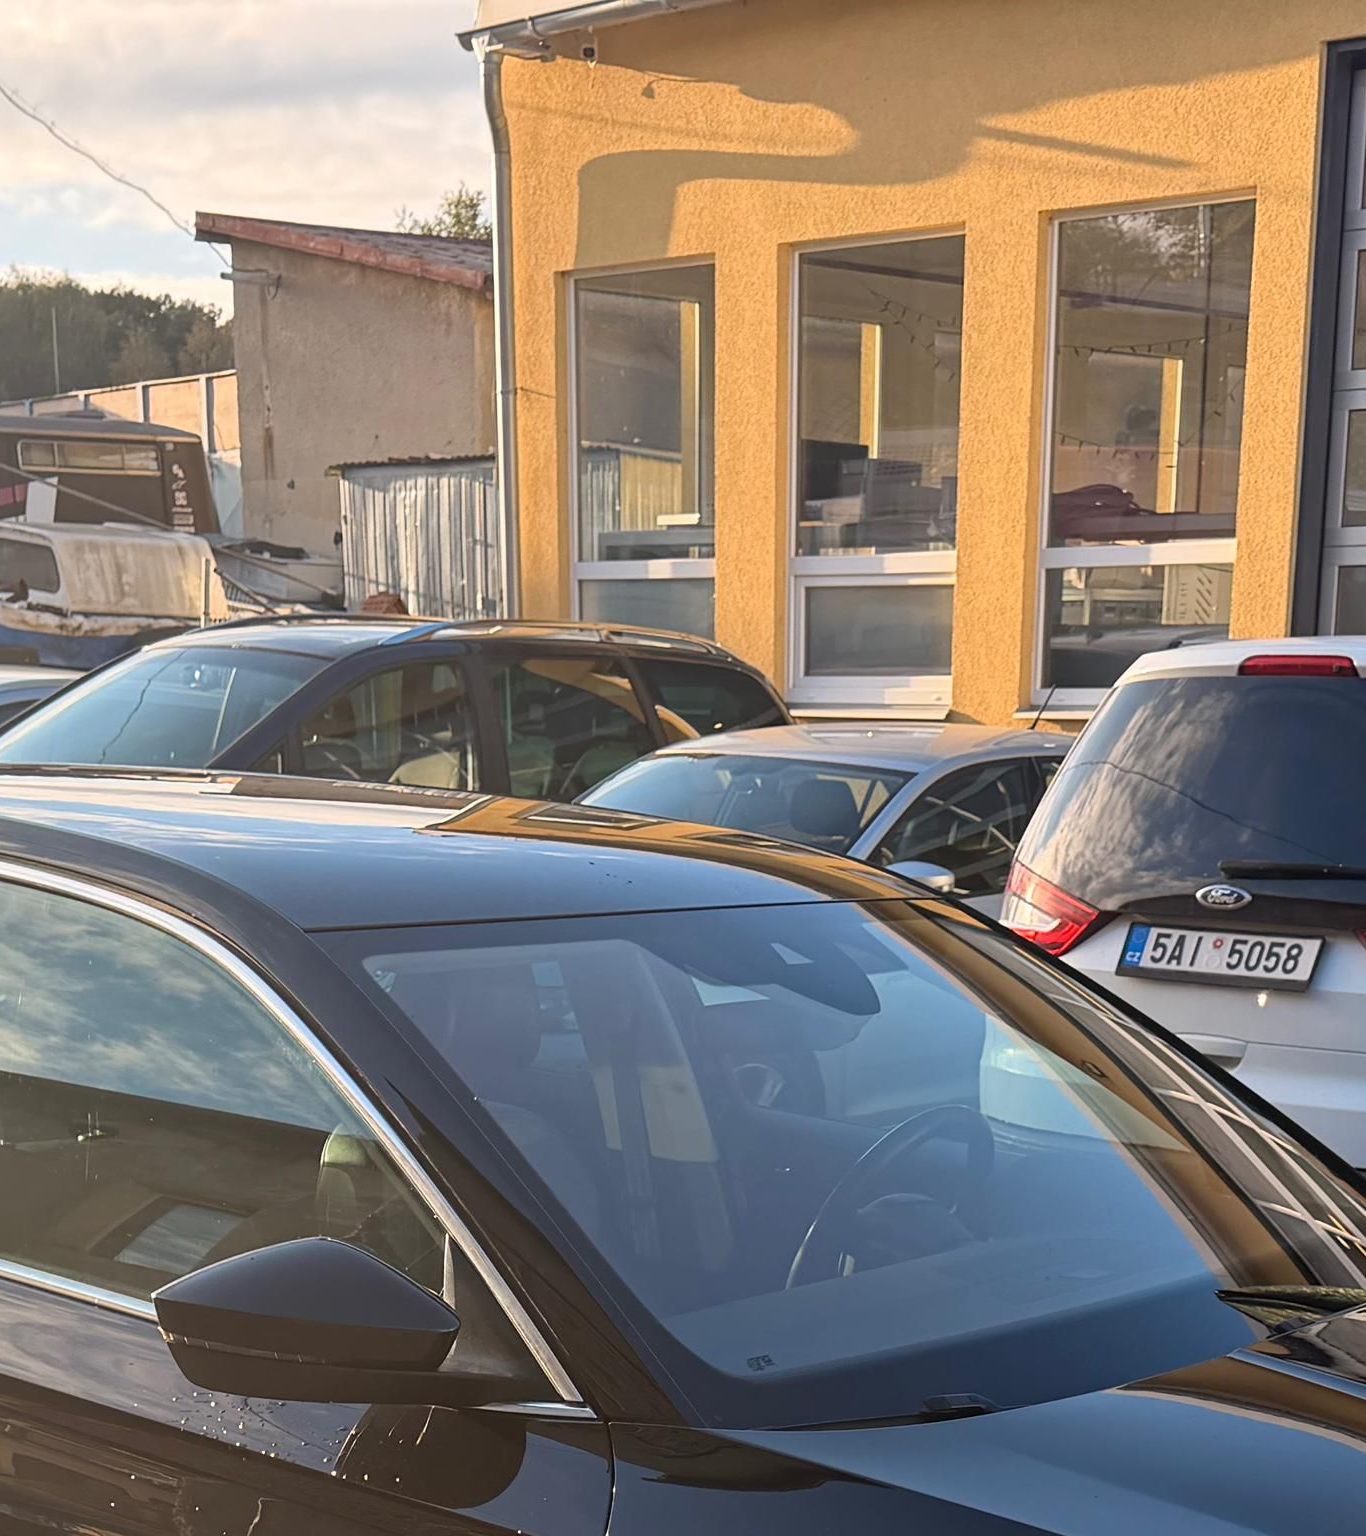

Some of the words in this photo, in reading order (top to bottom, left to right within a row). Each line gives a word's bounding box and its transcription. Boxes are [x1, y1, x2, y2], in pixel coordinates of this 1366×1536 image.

[1206, 888, 1238, 905] Ford
[1125, 951, 1141, 962] CZ
[1226, 939, 1303, 974] 5058
